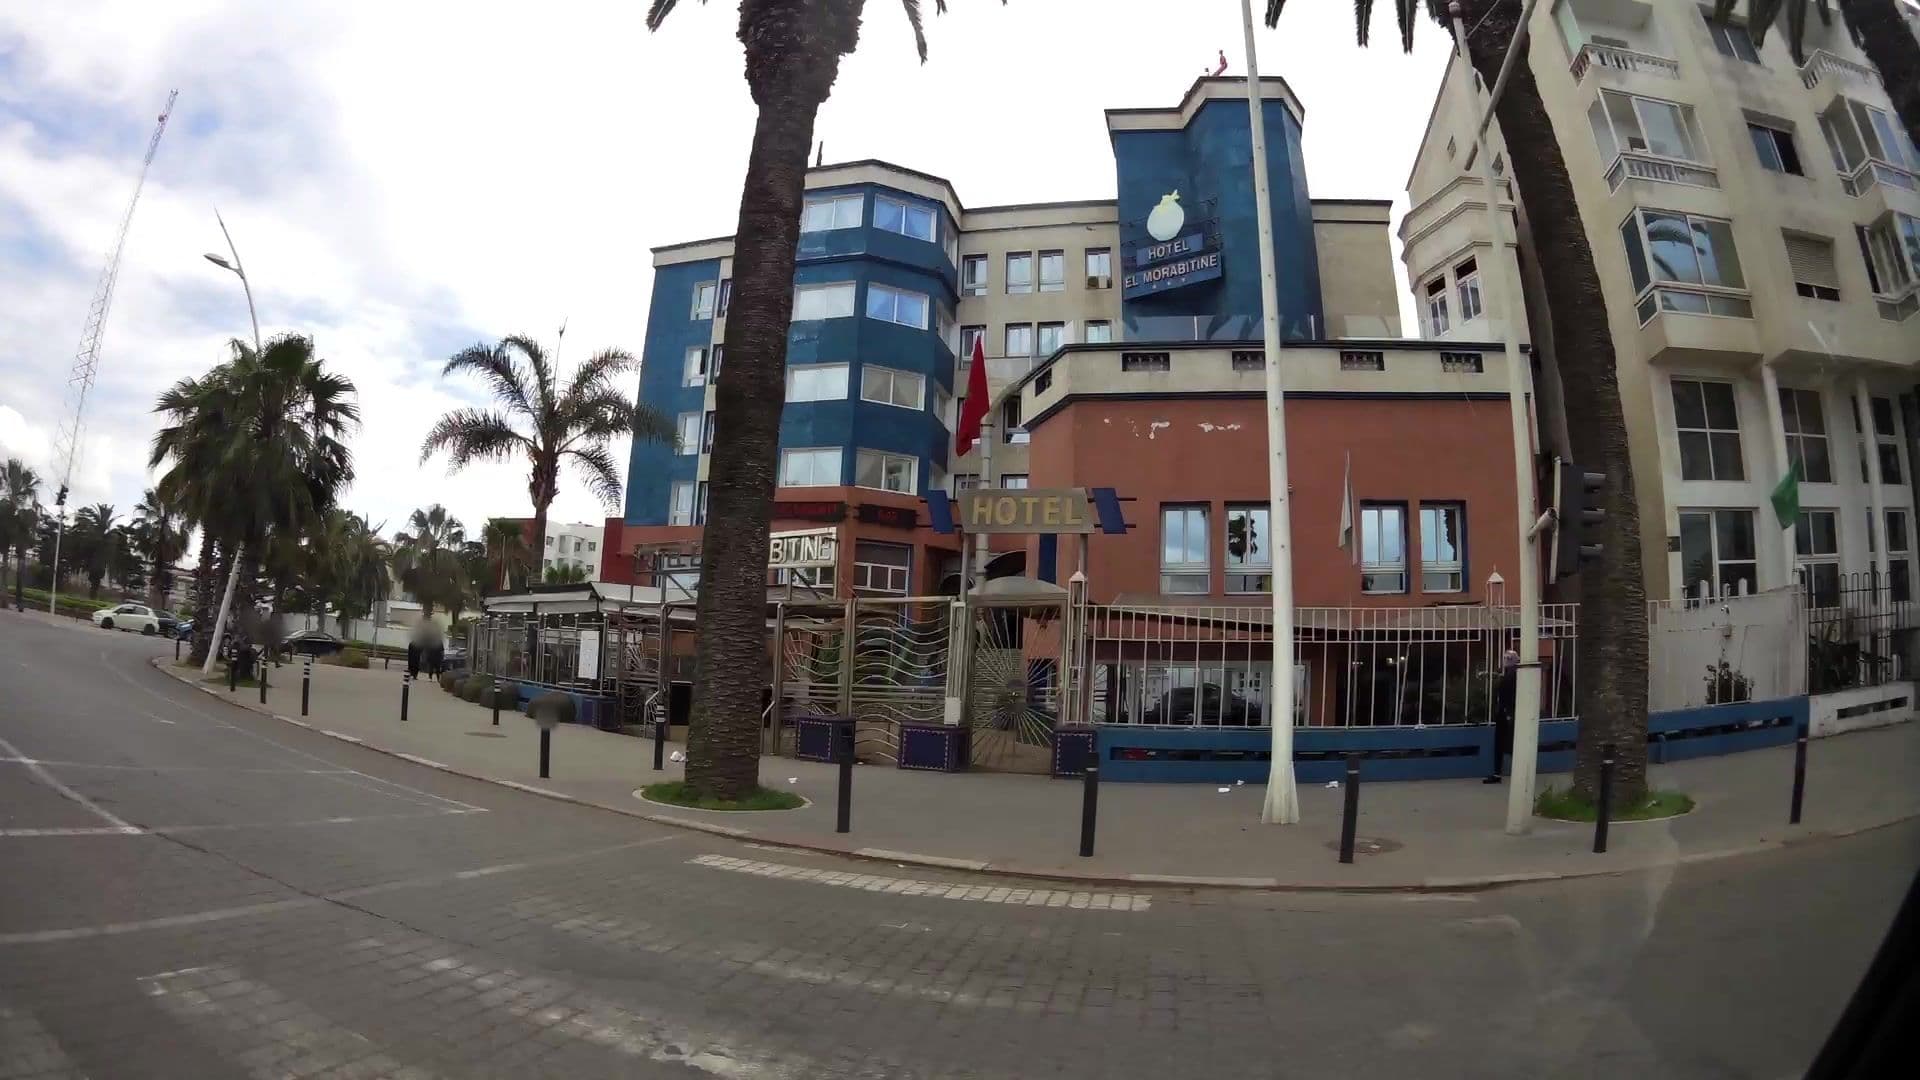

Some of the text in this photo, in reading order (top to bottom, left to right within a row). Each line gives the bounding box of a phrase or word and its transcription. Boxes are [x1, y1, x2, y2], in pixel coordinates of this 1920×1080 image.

[1148, 239, 1190, 259] HOTEL
[1125, 254, 1218, 289] EL MORABITINE
[972, 496, 1082, 526] HOTEL
